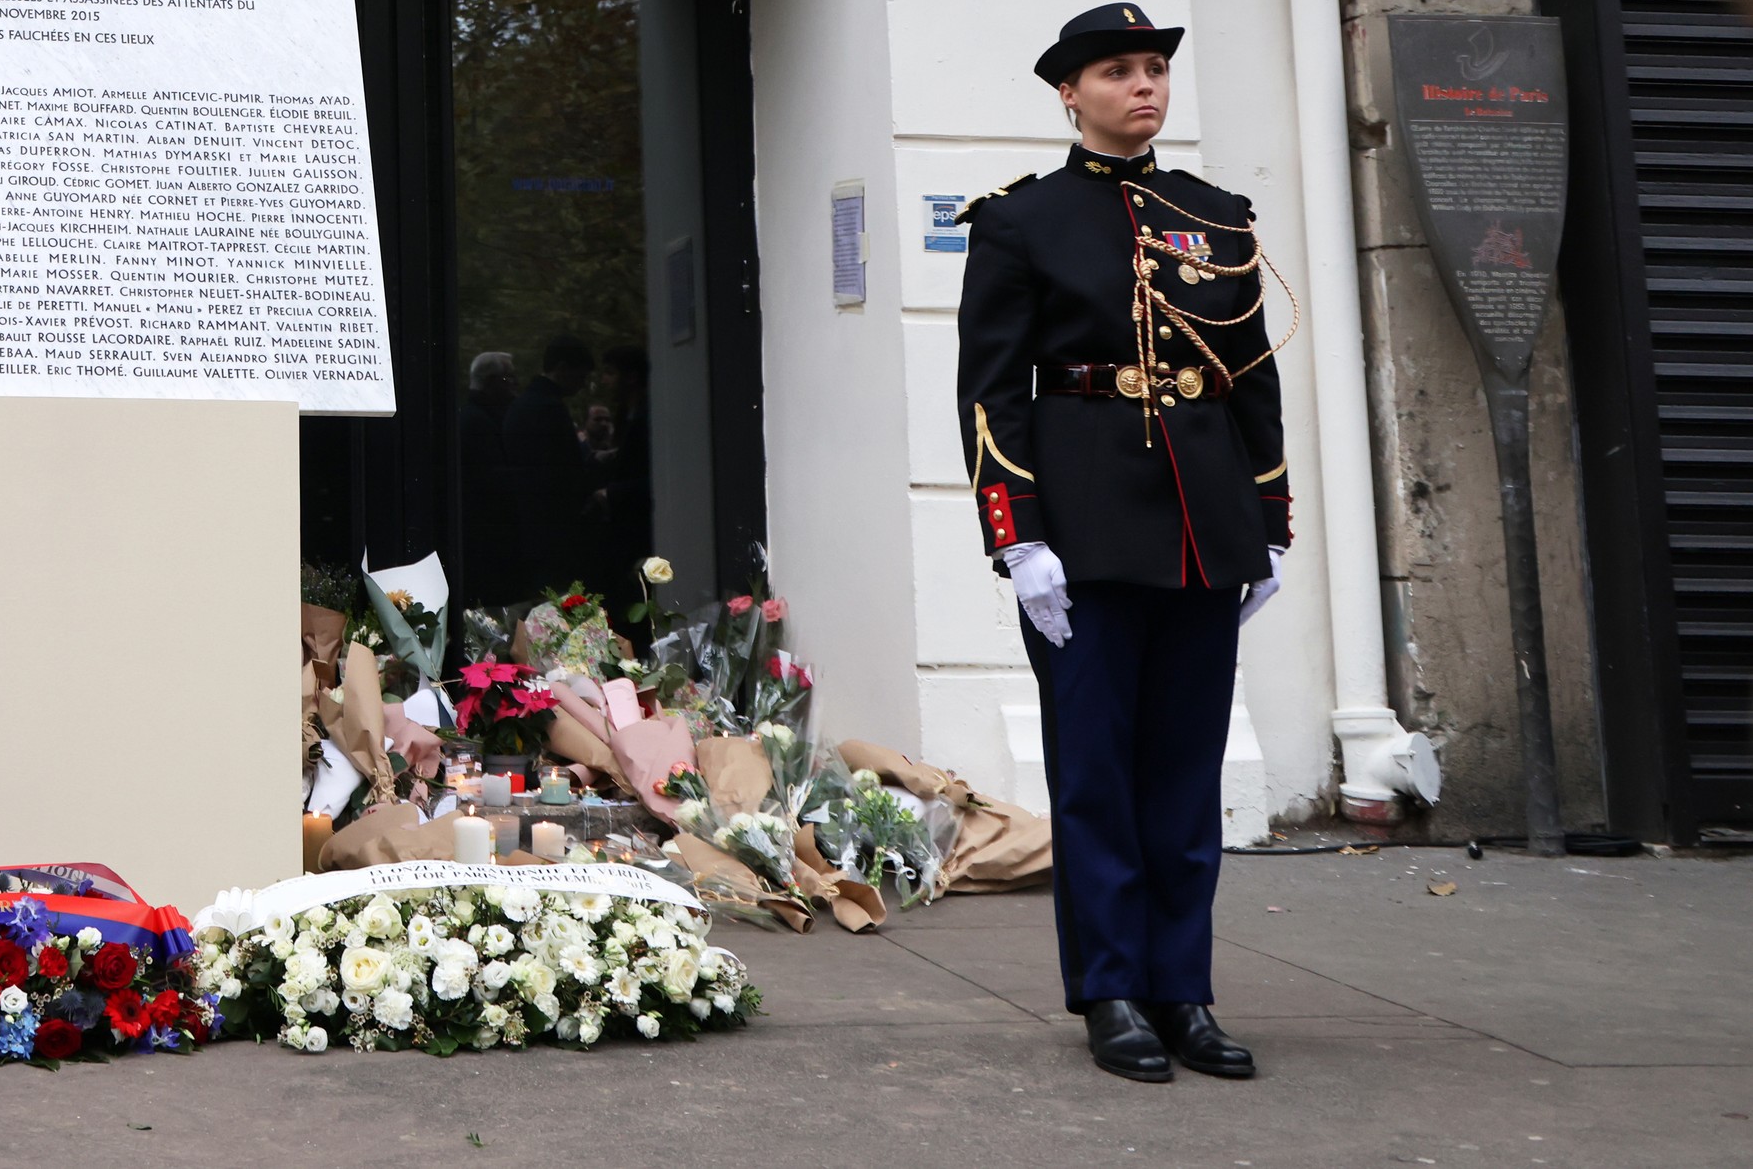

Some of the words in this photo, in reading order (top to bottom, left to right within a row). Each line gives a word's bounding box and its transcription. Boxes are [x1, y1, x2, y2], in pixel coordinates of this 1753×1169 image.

[236, 0, 256, 11] DU
[70, 9, 101, 22] 2015
[8, 27, 71, 43] FAUCHÉES
[94, 31, 118, 45] CES
[120, 33, 156, 46] LIEUX
[52, 87, 97, 99] AMIOT.
[152, 90, 265, 104] ANTICEVIC-PUMIR.
[318, 95, 356, 107] AYAD.
[1422, 84, 1483, 101] Histoire
[1488, 87, 1505, 101] de
[1509, 86, 1549, 103] Paris
[72, 102, 138, 115] BOUFFARD.
[192, 105, 266, 119] BOULENGER.
[313, 109, 357, 121] BREUIL.
[19, 145, 96, 159] DUPERRON.
[304, 153, 362, 165] LAUSCH.
[7, 174, 60, 187] GIROUD.
[104, 177, 152, 190] GOMET.
[303, 183, 365, 195] GARRIDO.
[934, 210, 957, 223] eps
[21, 236, 98, 250] LELLOUCHE.
[147, 239, 270, 254] MAITROT-TAPPREST.
[316, 244, 371, 256] MARTIN.
[48, 252, 107, 266] MERLIN.
[166, 256, 219, 268] MINOT.
[293, 258, 373, 271] MINVIELLE.
[45, 284, 114, 297] NAVARRET.
[198, 287, 376, 303] NEUET-SHALTER-BODINEAU.
[75, 363, 128, 378] THOMÉ.
[202, 367, 260, 380] VALETTE.
[311, 369, 384, 382] VERNADAL.
[372, 876, 404, 885] LIFE
[414, 872, 445, 880] FOR
[453, 871, 497, 880] PARIS
